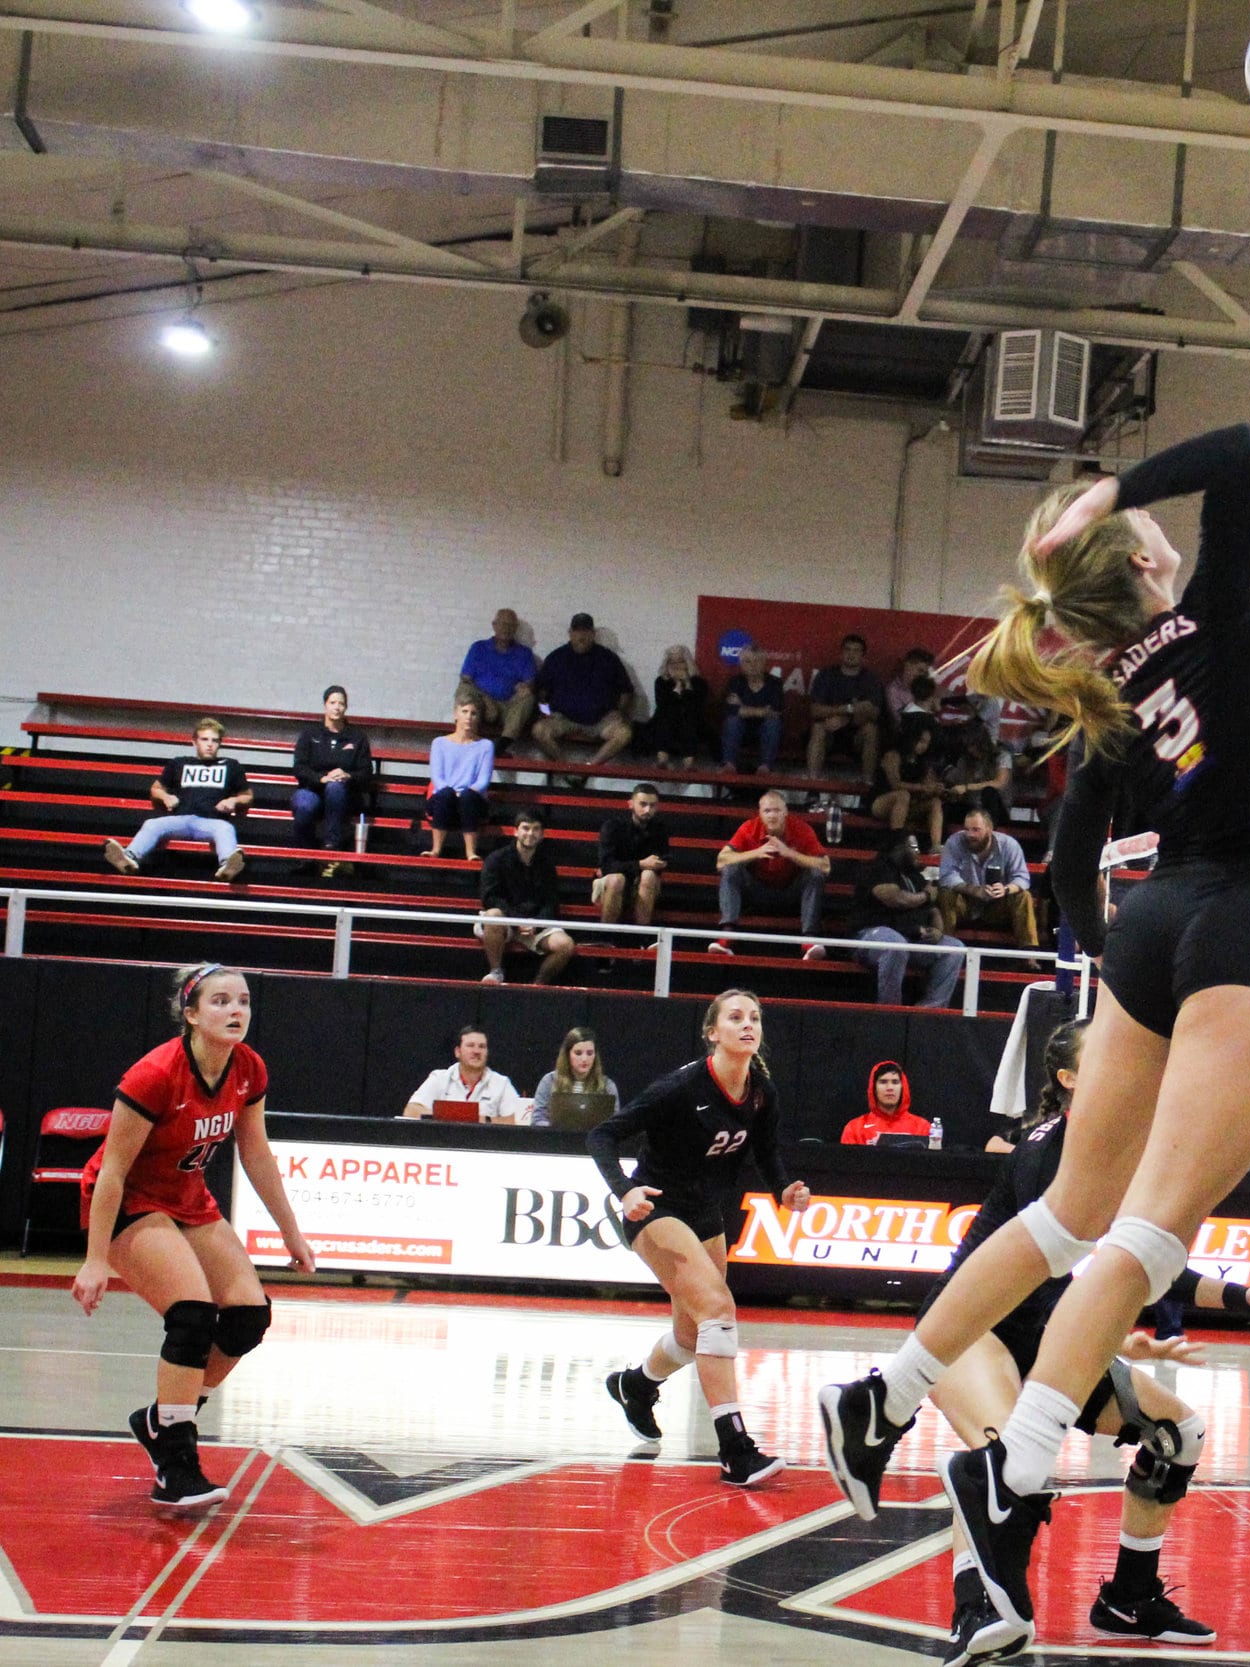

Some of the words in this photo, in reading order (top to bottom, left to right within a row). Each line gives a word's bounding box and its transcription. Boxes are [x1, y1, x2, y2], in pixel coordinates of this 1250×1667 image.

[1113, 615, 1198, 687] SADERS
[1134, 678, 1200, 761] 3
[184, 767, 224, 784] NGU
[54, 1112, 109, 1131] NGU
[194, 1111, 234, 1141] NGU
[705, 1129, 748, 1157] 22
[319, 1158, 459, 1187] APPAREL
[497, 1186, 634, 1252] BB&
[735, 1198, 944, 1260] NORTH
